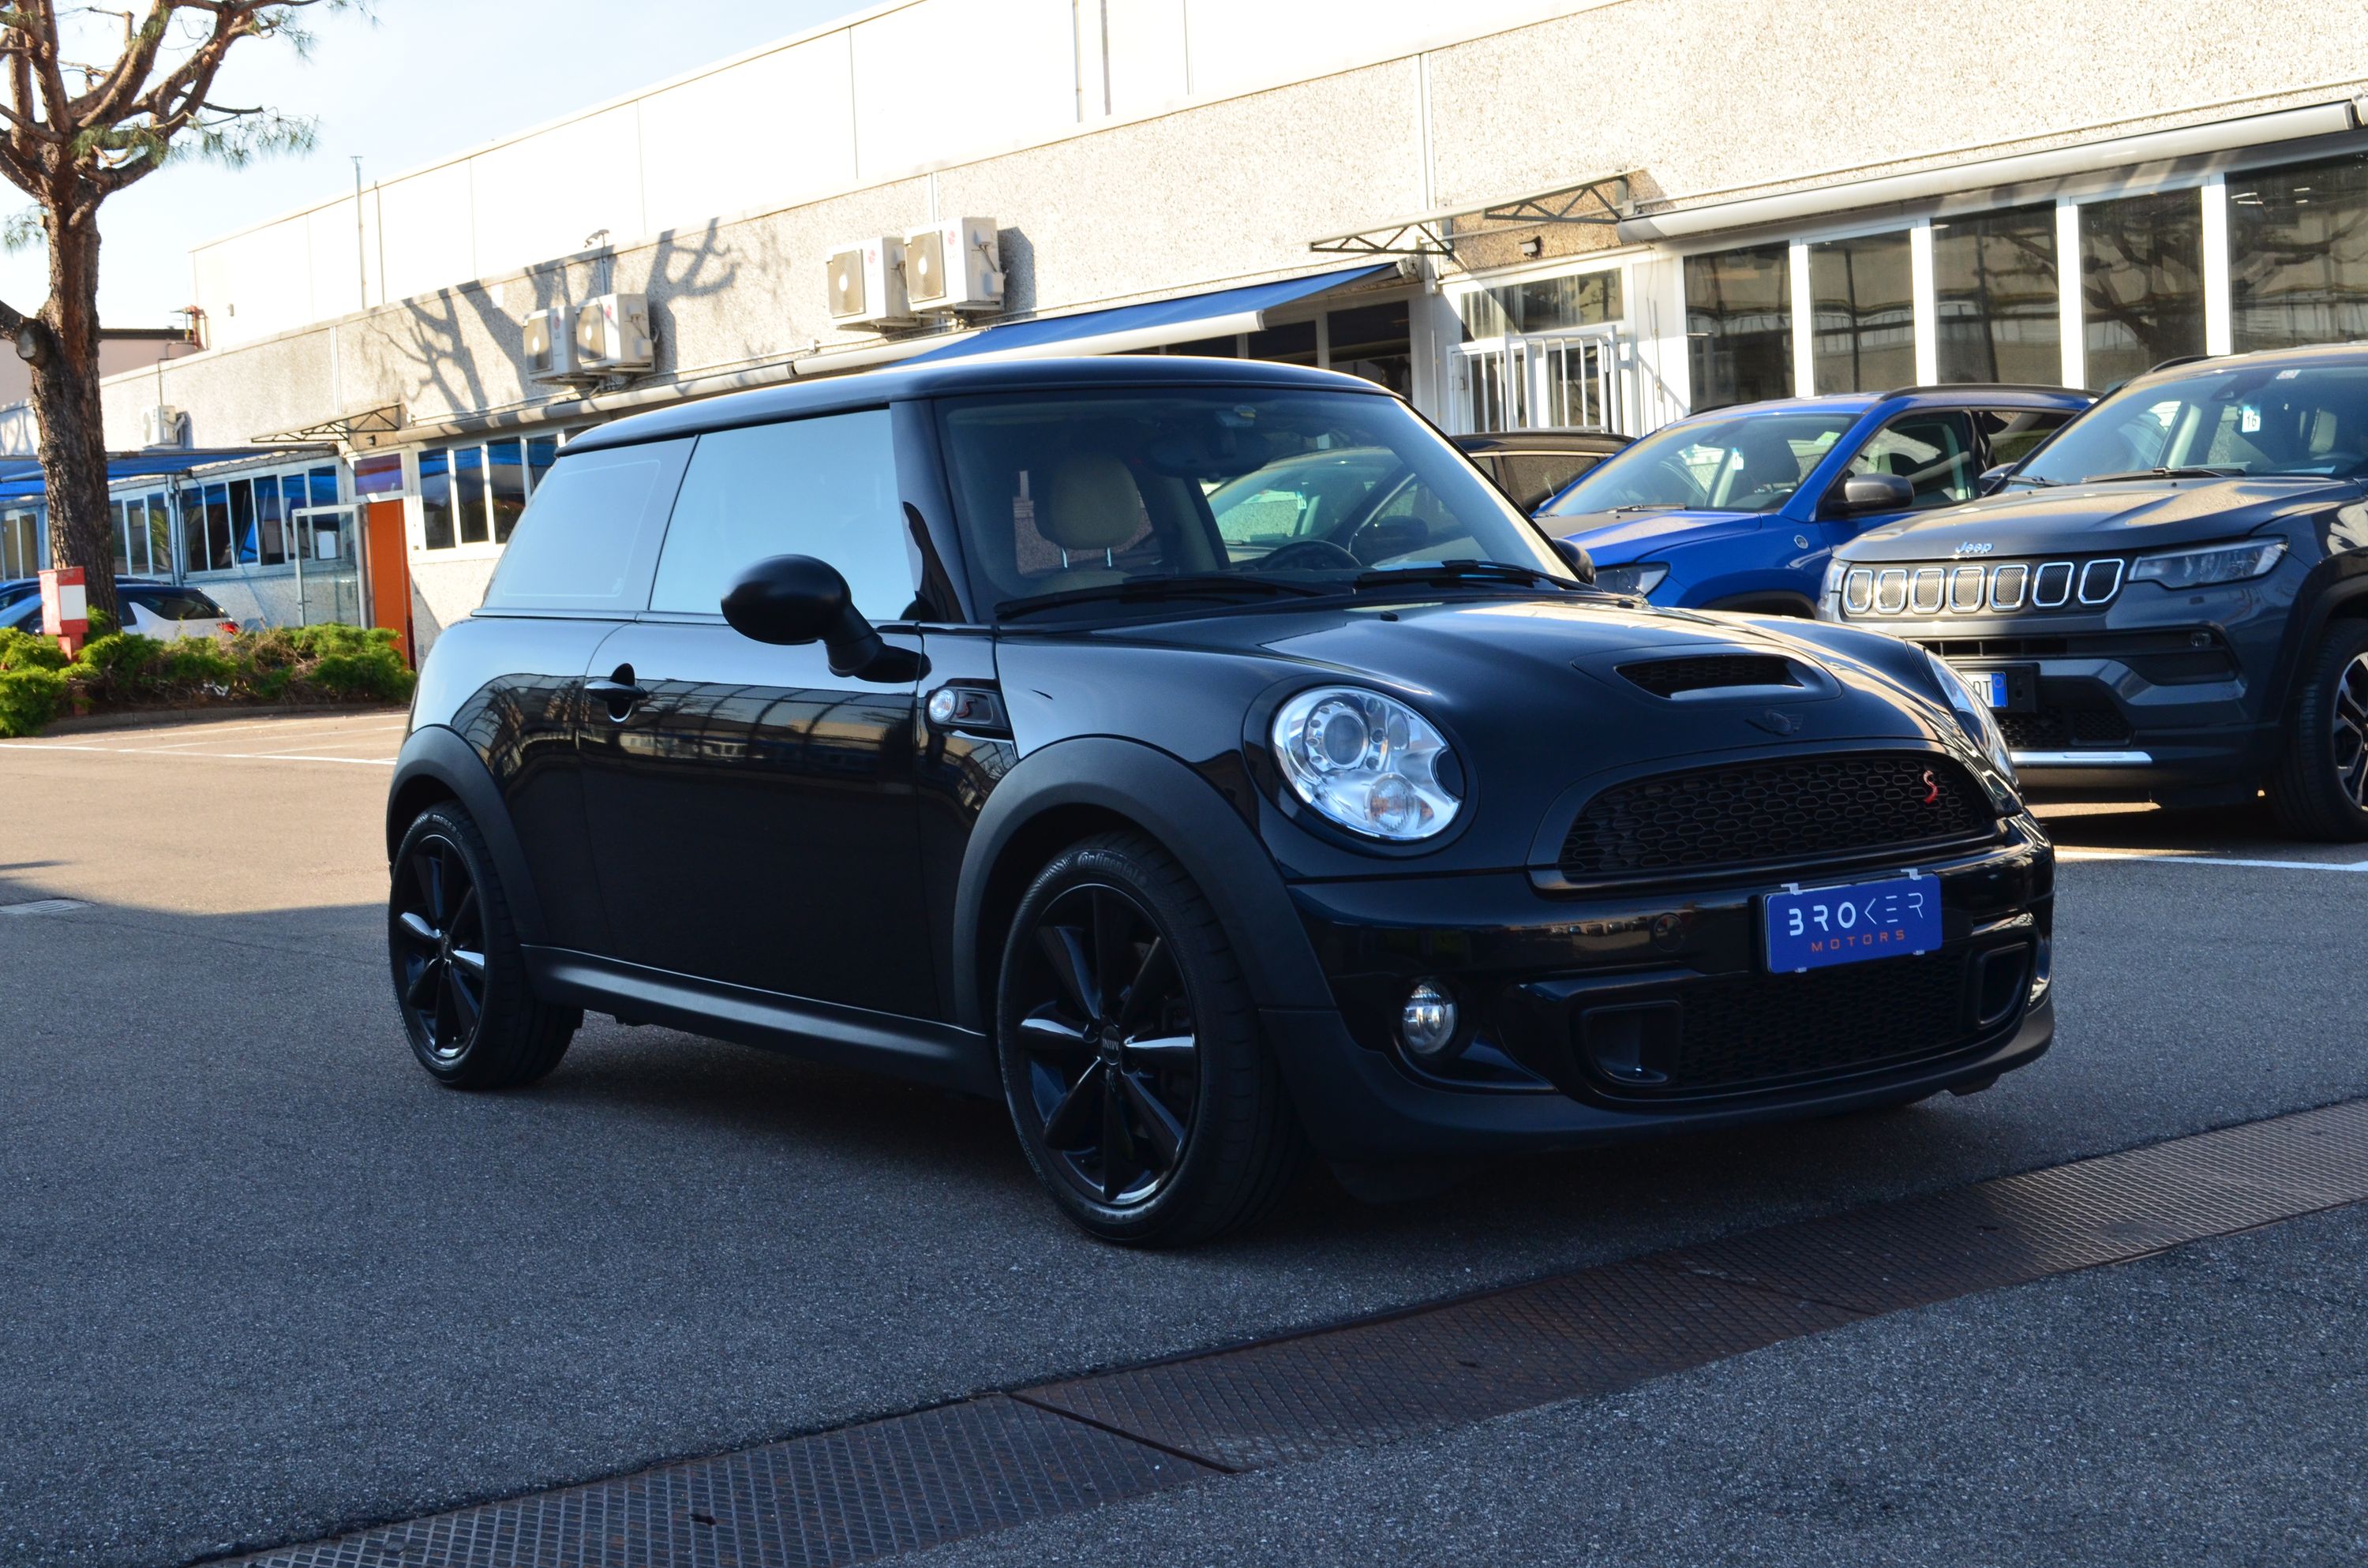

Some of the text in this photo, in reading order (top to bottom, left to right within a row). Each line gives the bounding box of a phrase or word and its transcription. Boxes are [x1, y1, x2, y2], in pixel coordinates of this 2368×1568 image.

[1955, 541, 1994, 554] Jeep
[1923, 769, 1939, 804] S
[1789, 893, 1924, 936] BROKER
[1811, 930, 1905, 952] MOTORS
